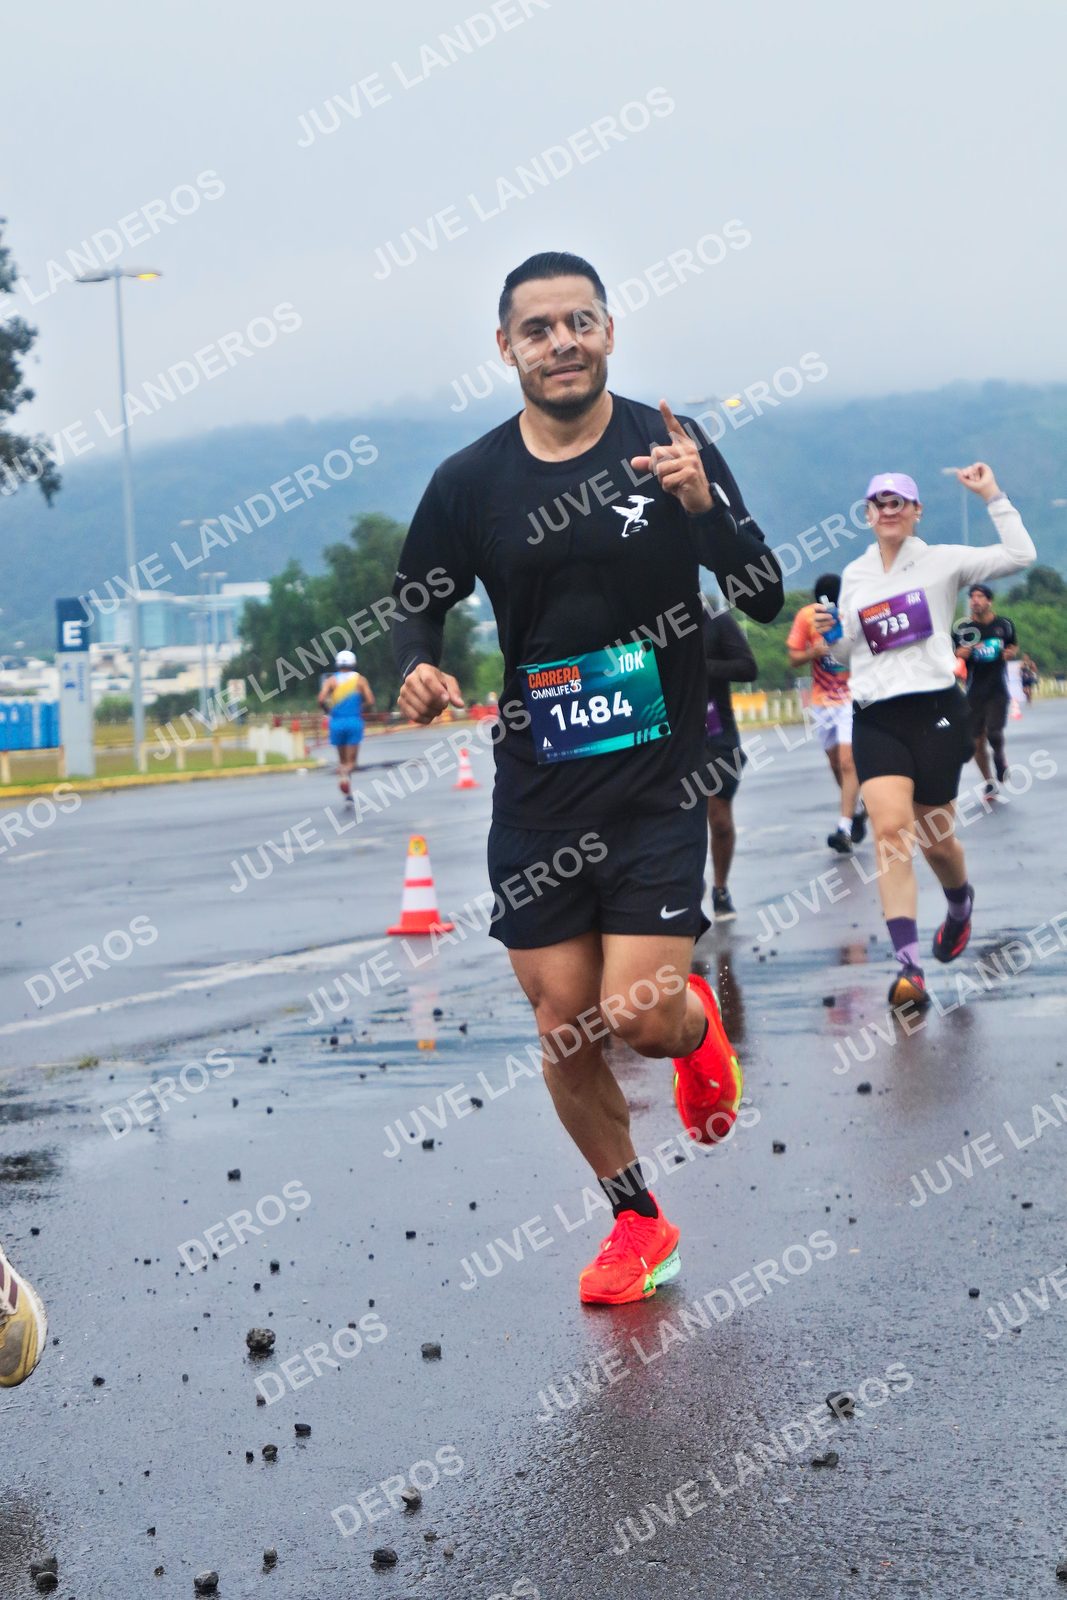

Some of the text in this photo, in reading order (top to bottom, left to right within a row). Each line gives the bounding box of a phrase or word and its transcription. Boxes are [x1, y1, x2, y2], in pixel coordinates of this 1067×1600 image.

[62, 620, 83, 647] E
[878, 612, 910, 637] 733
[618, 649, 645, 674] 10K
[528, 665, 581, 689] CARRERA
[531, 684, 571, 700] OMNILIFE
[550, 691, 633, 731] 1484
